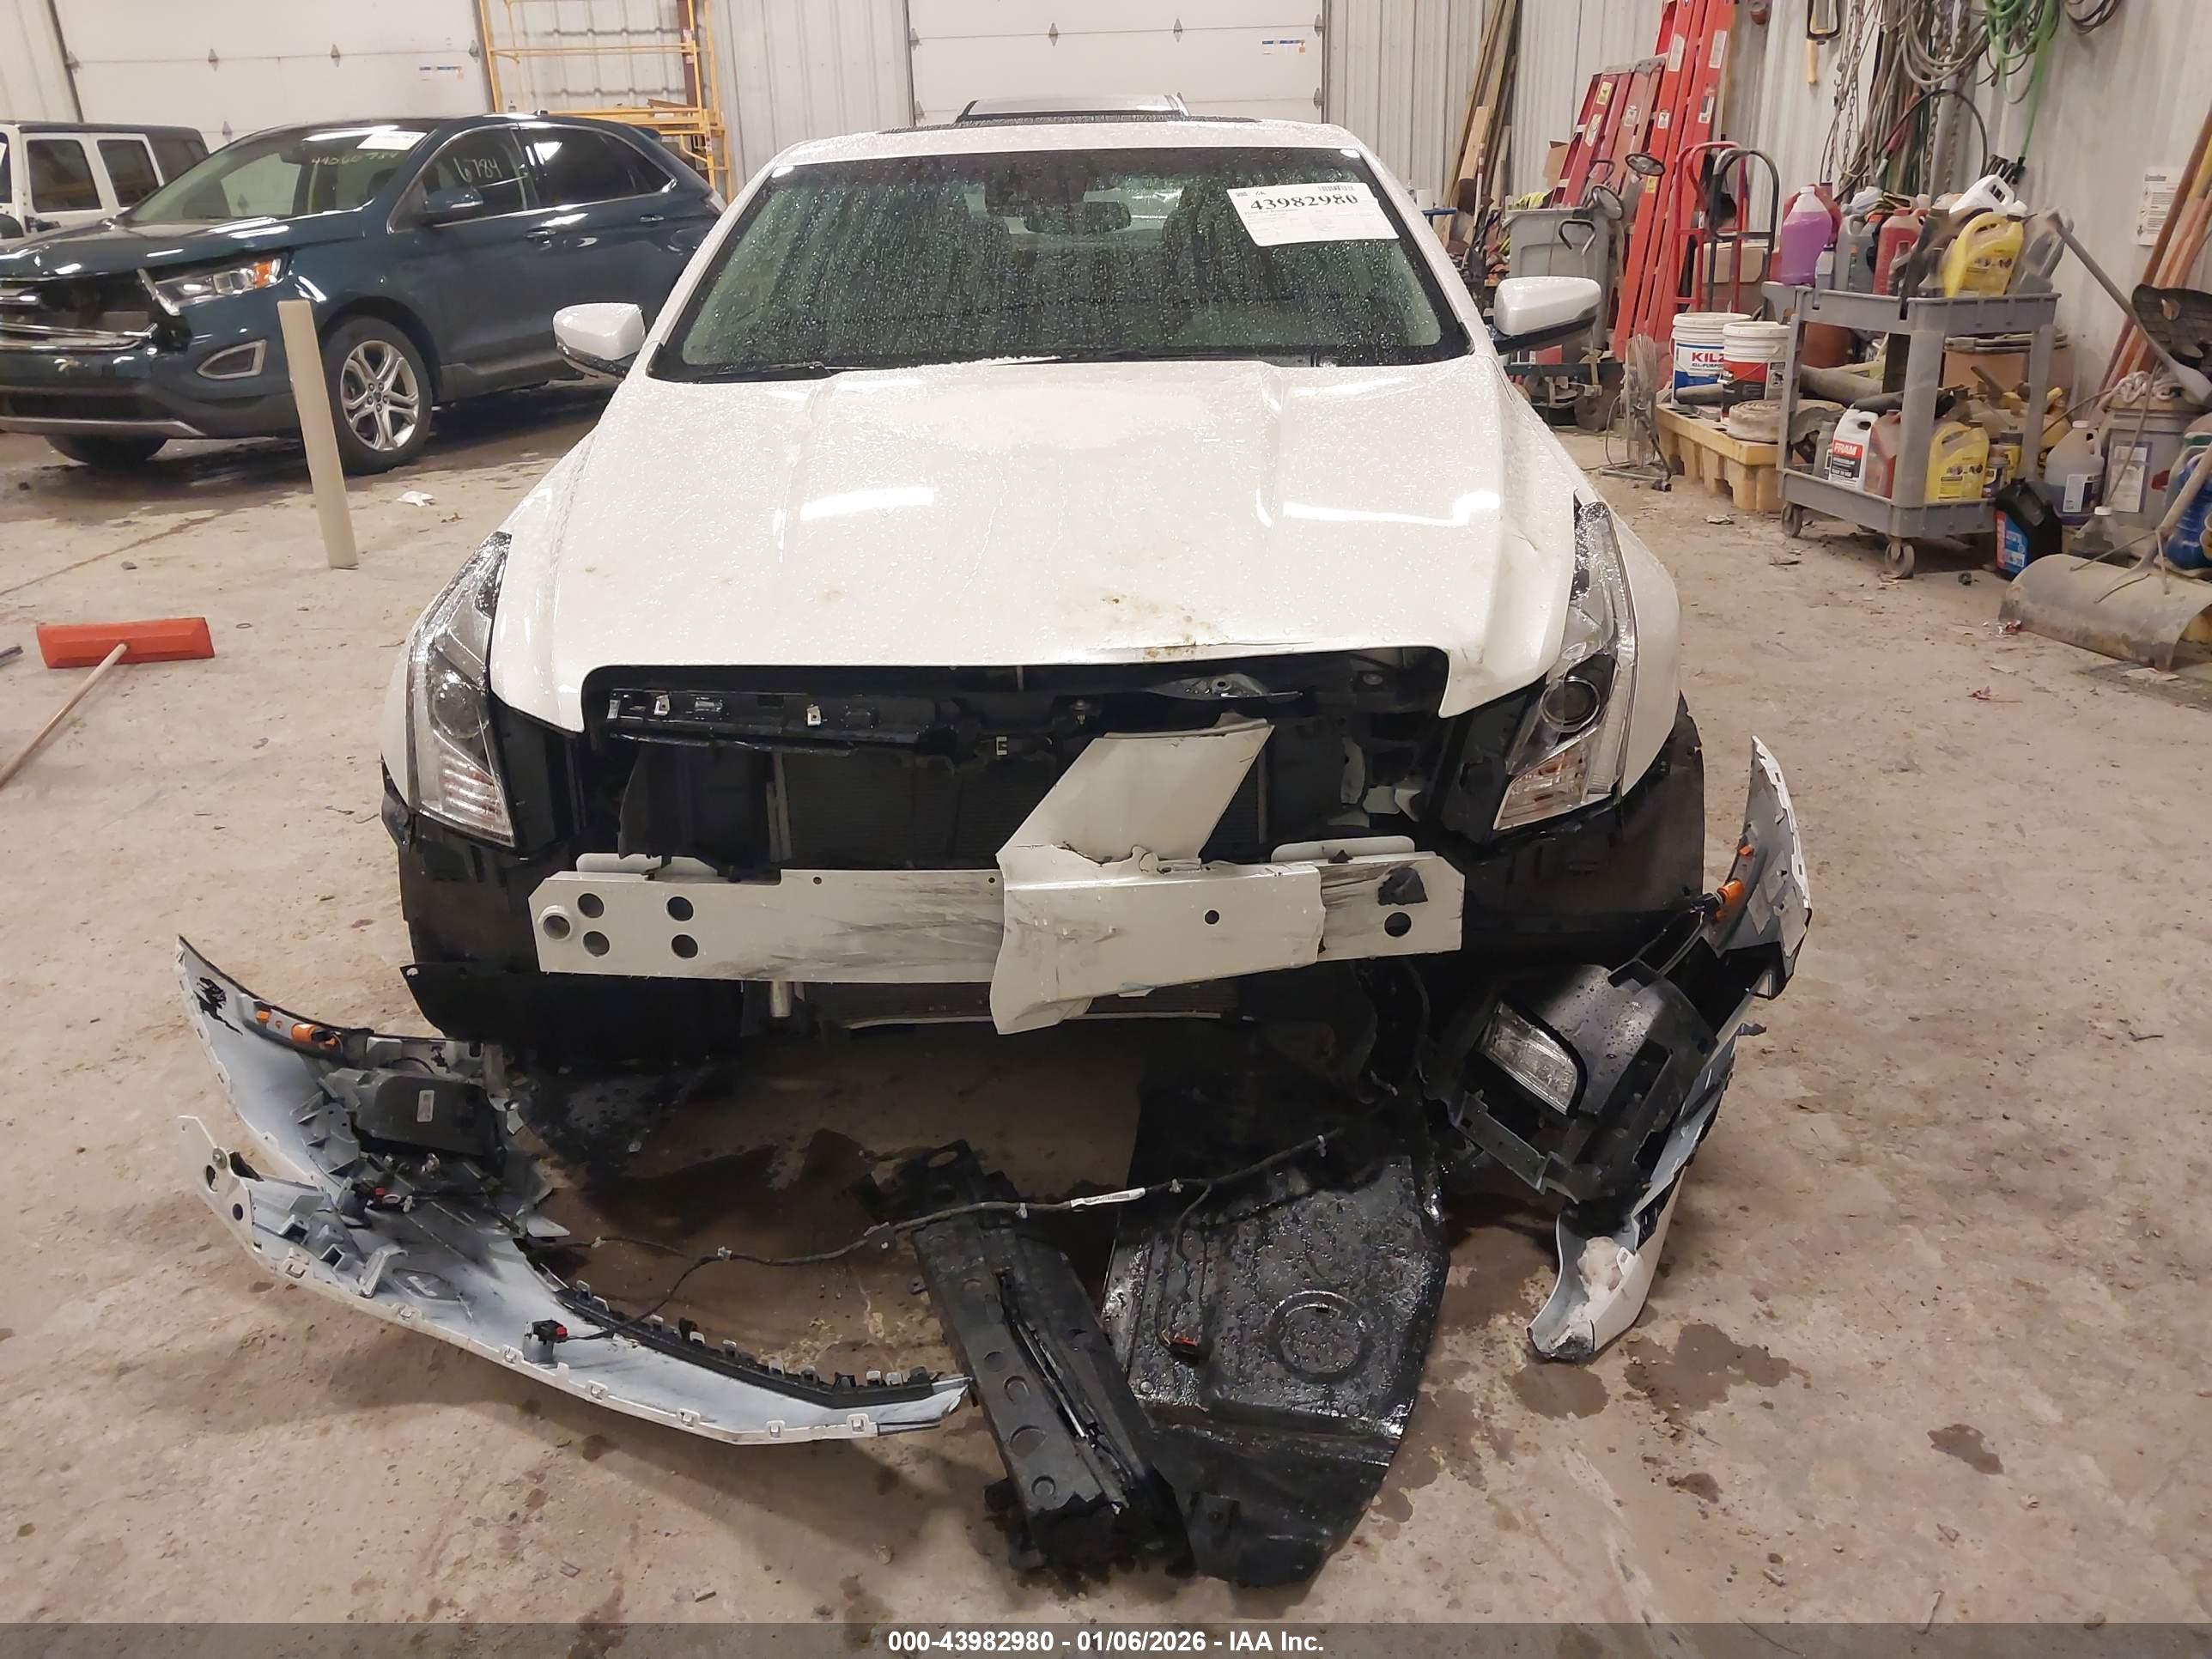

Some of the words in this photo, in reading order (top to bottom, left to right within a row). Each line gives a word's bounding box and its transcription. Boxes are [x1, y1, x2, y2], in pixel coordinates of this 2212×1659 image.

[453, 157, 502, 183] 6784
[1250, 193, 1358, 210] 43982980
[1834, 442, 1857, 456] FRAM
